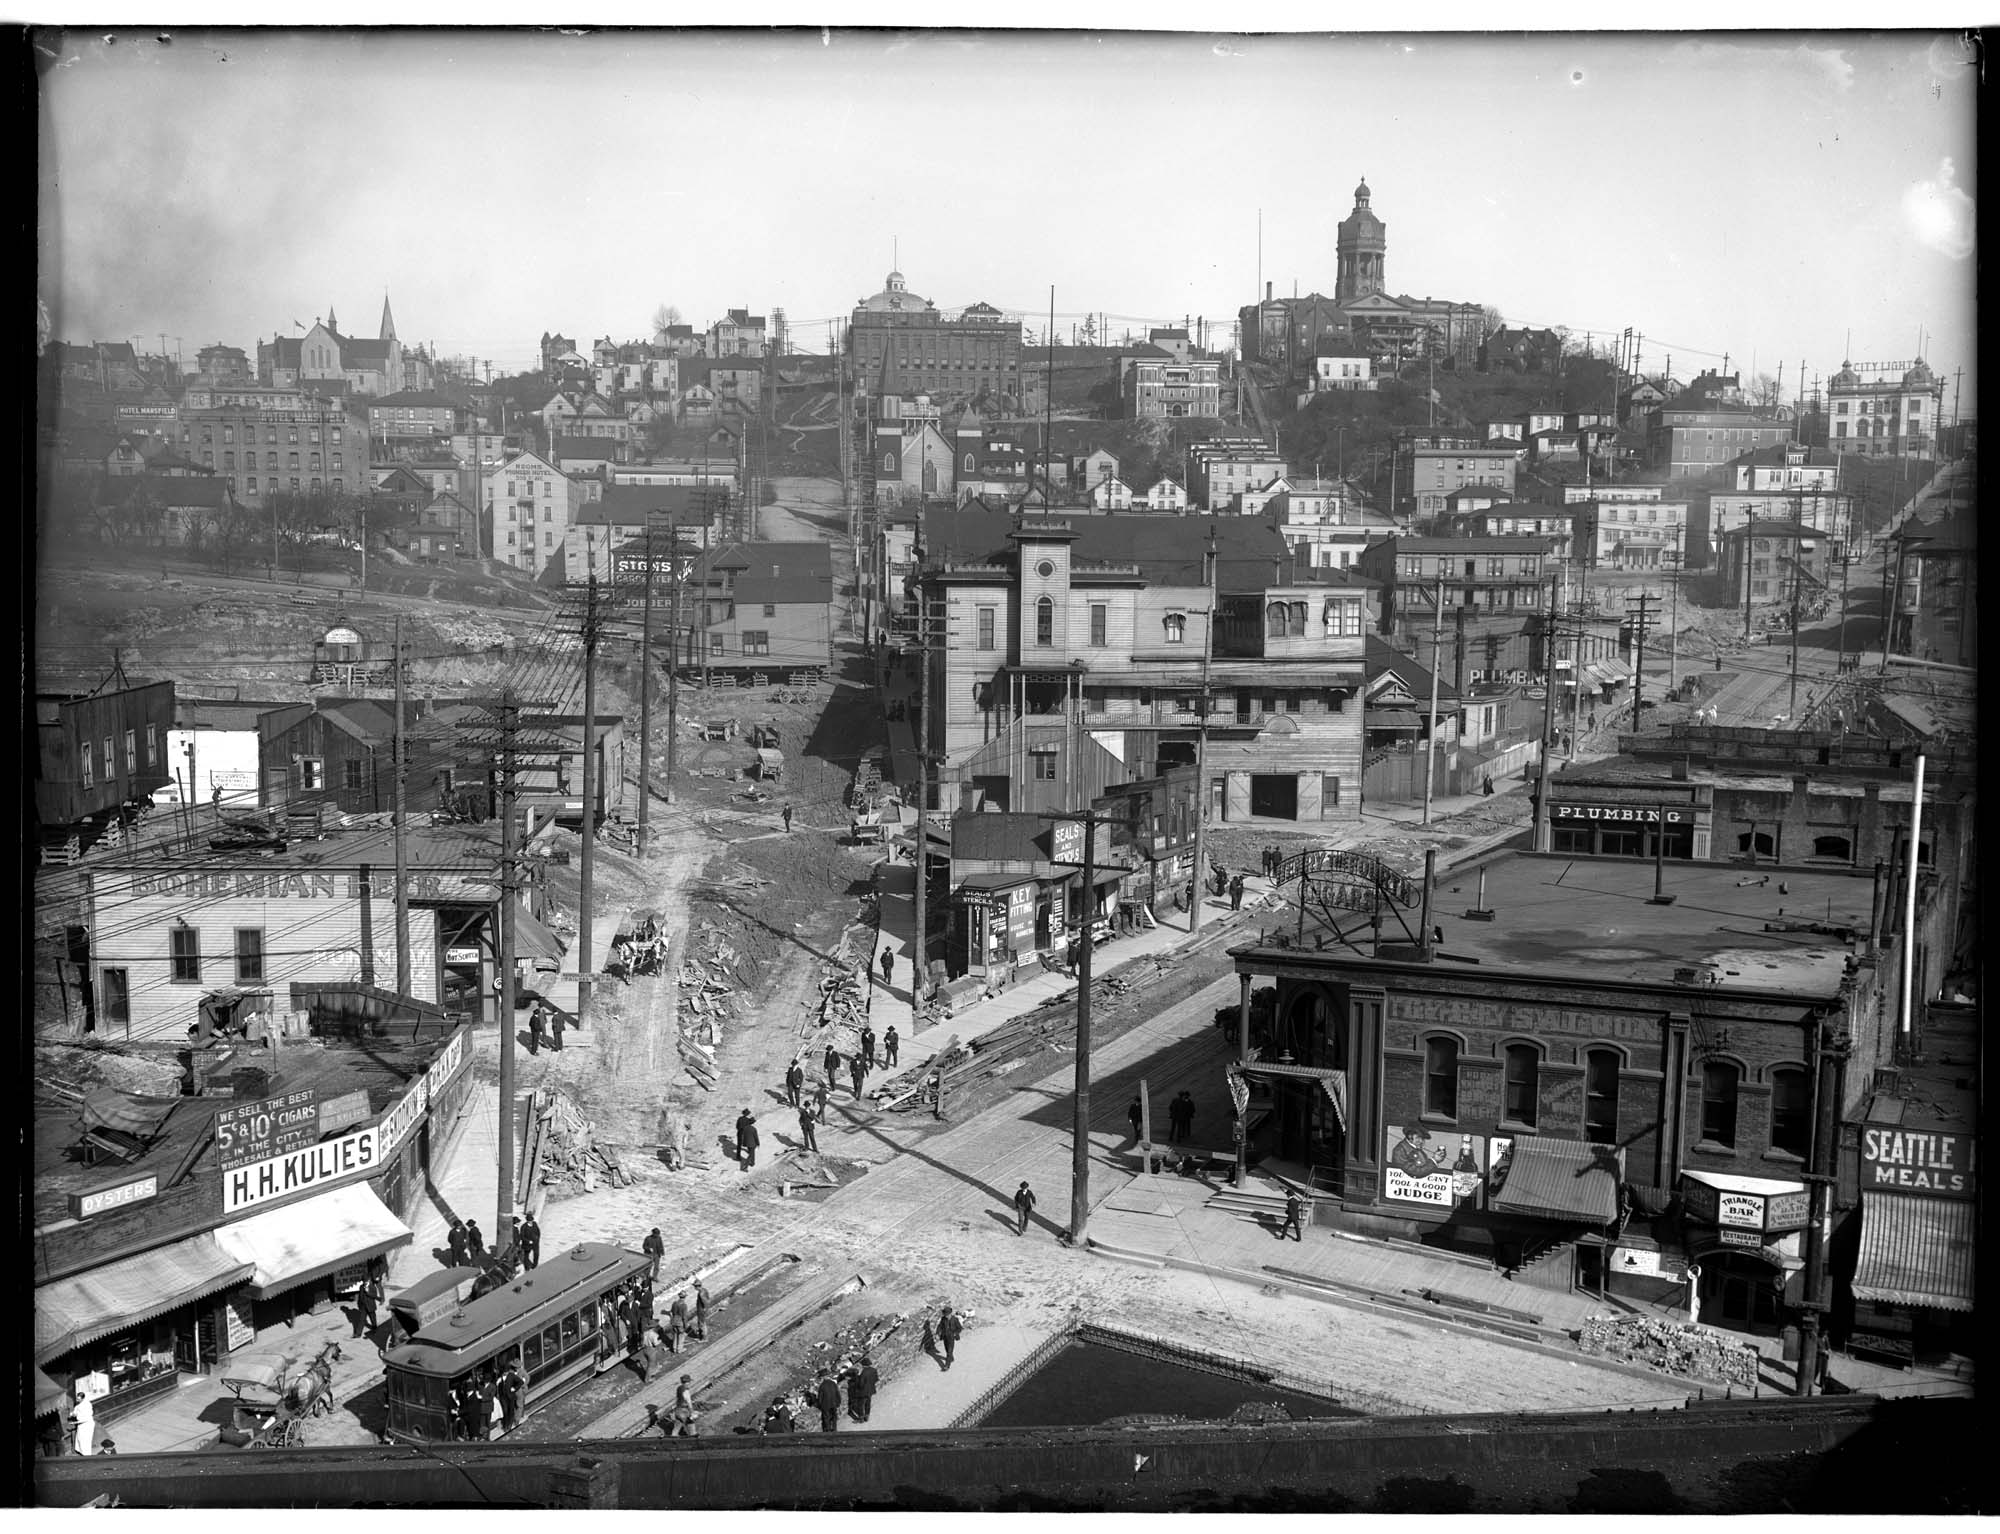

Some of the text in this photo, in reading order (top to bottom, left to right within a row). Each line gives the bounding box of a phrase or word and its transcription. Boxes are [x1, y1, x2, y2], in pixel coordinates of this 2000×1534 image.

[1854, 360, 1913, 372] CITY LIGHT
[618, 560, 672, 573] SIGNS
[624, 599, 673, 608] JOBBER
[1558, 806, 1682, 823] PLUMBING
[1055, 824, 1079, 844] SEALS
[1061, 842, 1072, 851] AND
[131, 873, 334, 898] BOHEMIAN
[962, 896, 994, 905] STENCILS
[1012, 886, 1031, 906] KEY
[1010, 902, 1033, 918] FITTING
[219, 1110, 239, 1123] WE
[238, 1103, 263, 1119] SELL
[266, 1097, 286, 1111] THE
[288, 1090, 314, 1105] BEST
[240, 1123, 249, 1137] &
[278, 1104, 316, 1127] CIGARS
[221, 1137, 315, 1172] WHOLESALE & RETAIL
[234, 1146, 245, 1157] IN
[248, 1139, 270, 1154] THE
[1863, 1128, 1956, 1170] SEATTLE
[1390, 1178, 1411, 1187] FOOL
[1421, 1182, 1447, 1191] GOOD
[1427, 1175, 1449, 1184] CAN'T
[1875, 1165, 1965, 1192] MEALS
[84, 1180, 154, 1211] OYSTERS
[1393, 1187, 1443, 1201] JUDGE
[1721, 1197, 1763, 1212] TRIANGLE
[1729, 1206, 1754, 1217] BAR
[1722, 1231, 1761, 1242] RESTAURANT
